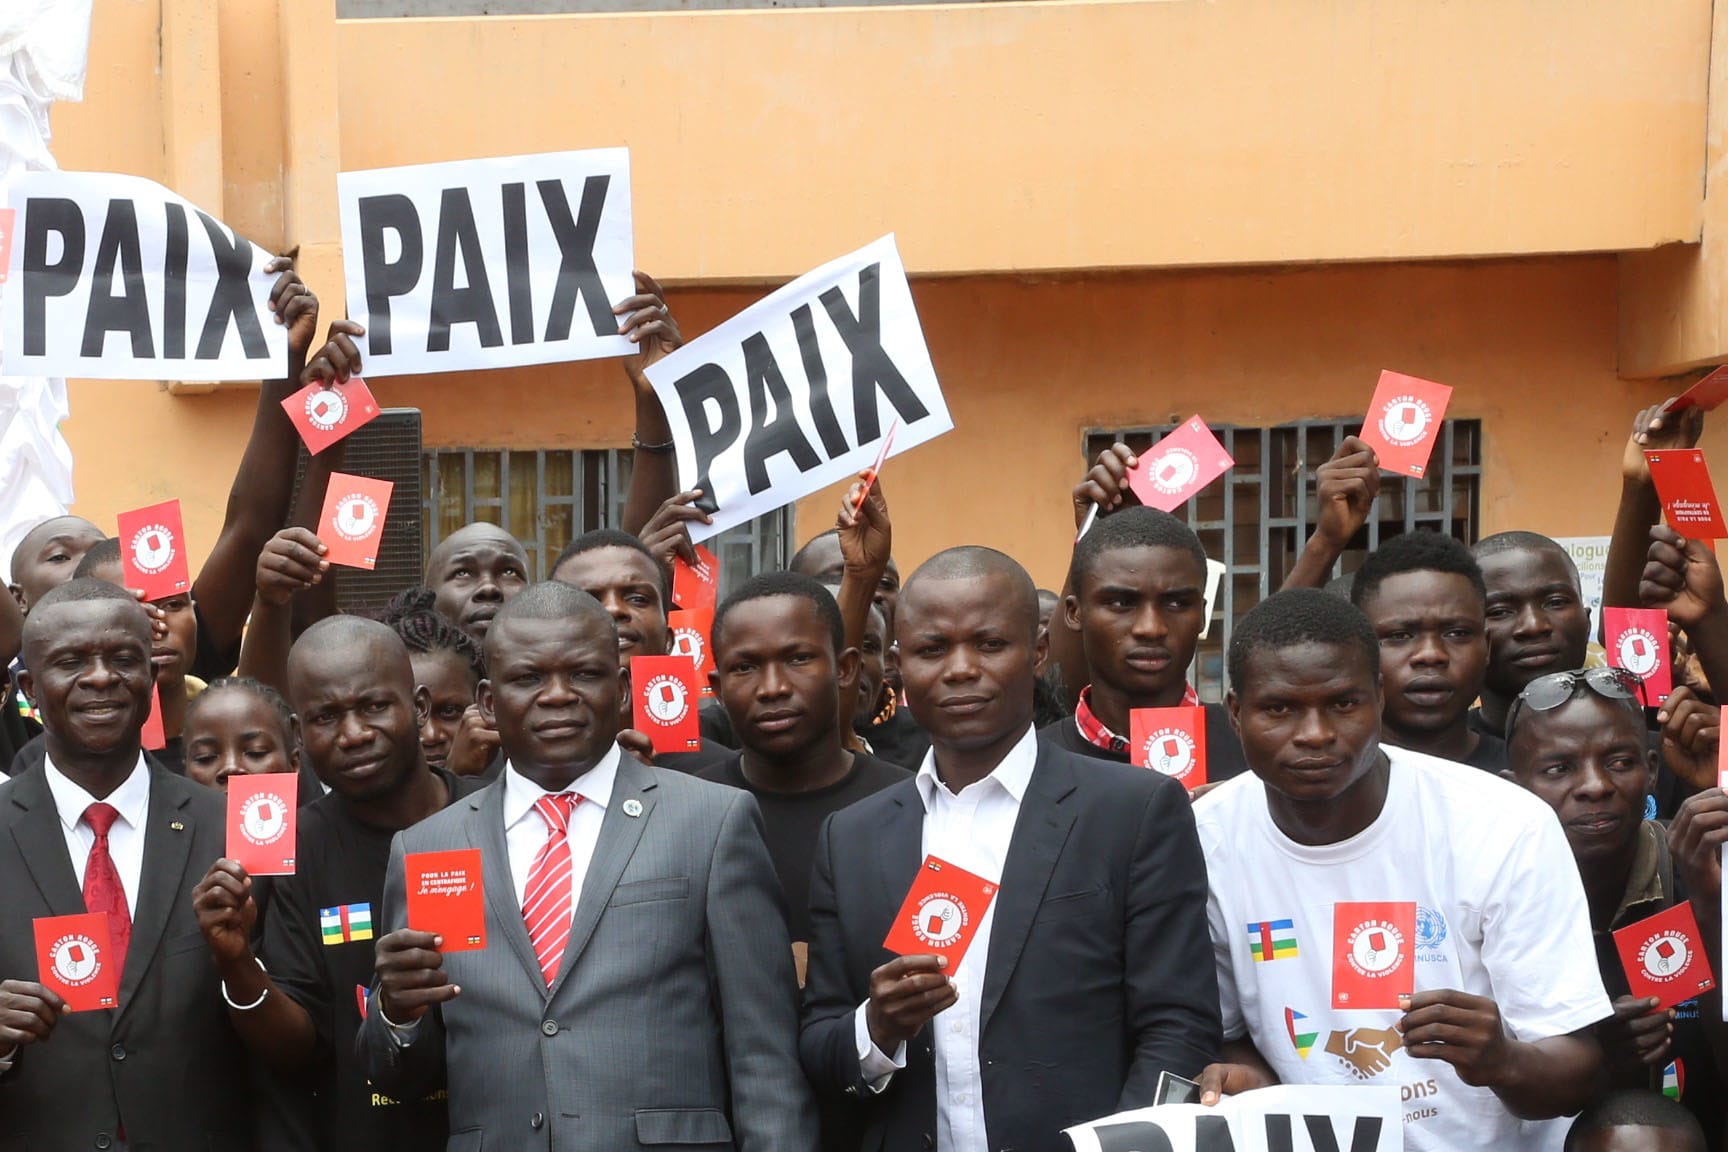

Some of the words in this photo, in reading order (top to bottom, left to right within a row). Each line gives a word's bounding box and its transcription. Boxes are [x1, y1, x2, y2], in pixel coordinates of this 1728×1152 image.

[358, 175, 619, 356] PAIX
[22, 198, 271, 359] PAIX
[674, 261, 930, 512] PAIX
[643, 675, 665, 696] CARTON
[417, 886, 428, 895] Je
[916, 891, 949, 907] VIOLENCE
[956, 900, 968, 927] CONTRE
[911, 913, 926, 941] ROUGE
[927, 932, 962, 946] CARTON
[1346, 919, 1376, 944] CARTON
[1381, 920, 1405, 944] ROUGE
[49, 934, 73, 957] CARTON
[77, 934, 100, 954] ROUGE
[1637, 932, 1660, 962] CARTON
[1664, 930, 1690, 943] ROUGE
[50, 964, 70, 985] CONTRE
[79, 962, 101, 985] VIOLENCE
[1346, 952, 1367, 976] CONTRE
[1377, 953, 1405, 977] VIOLENCE
[1640, 967, 1663, 982] CONTRE
[1673, 949, 1693, 978] VIOLENCE
